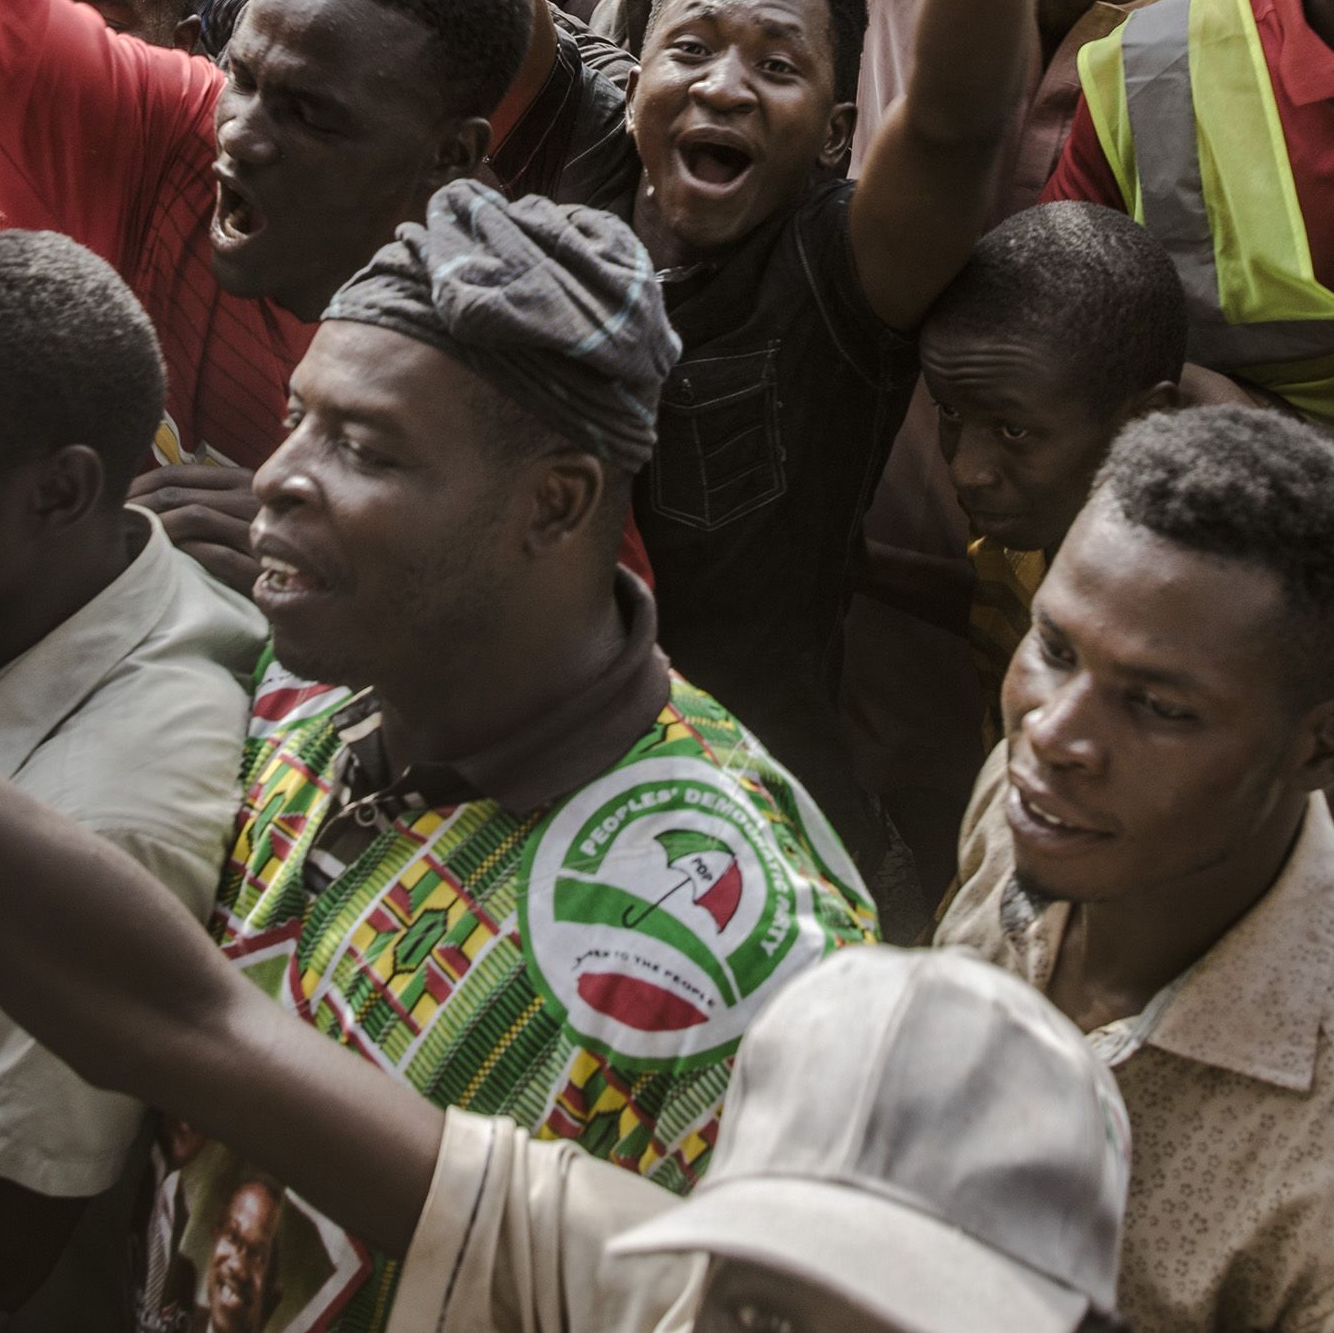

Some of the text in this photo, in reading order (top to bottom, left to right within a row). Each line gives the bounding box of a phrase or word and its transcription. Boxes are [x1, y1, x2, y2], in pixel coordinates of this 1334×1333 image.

[579, 787, 678, 858] PEOPLES'
[760, 894, 792, 958] PARTY
[691, 856, 714, 882] PDP
[634, 954, 660, 973] THE
[664, 970, 717, 1009] PEOPLE
